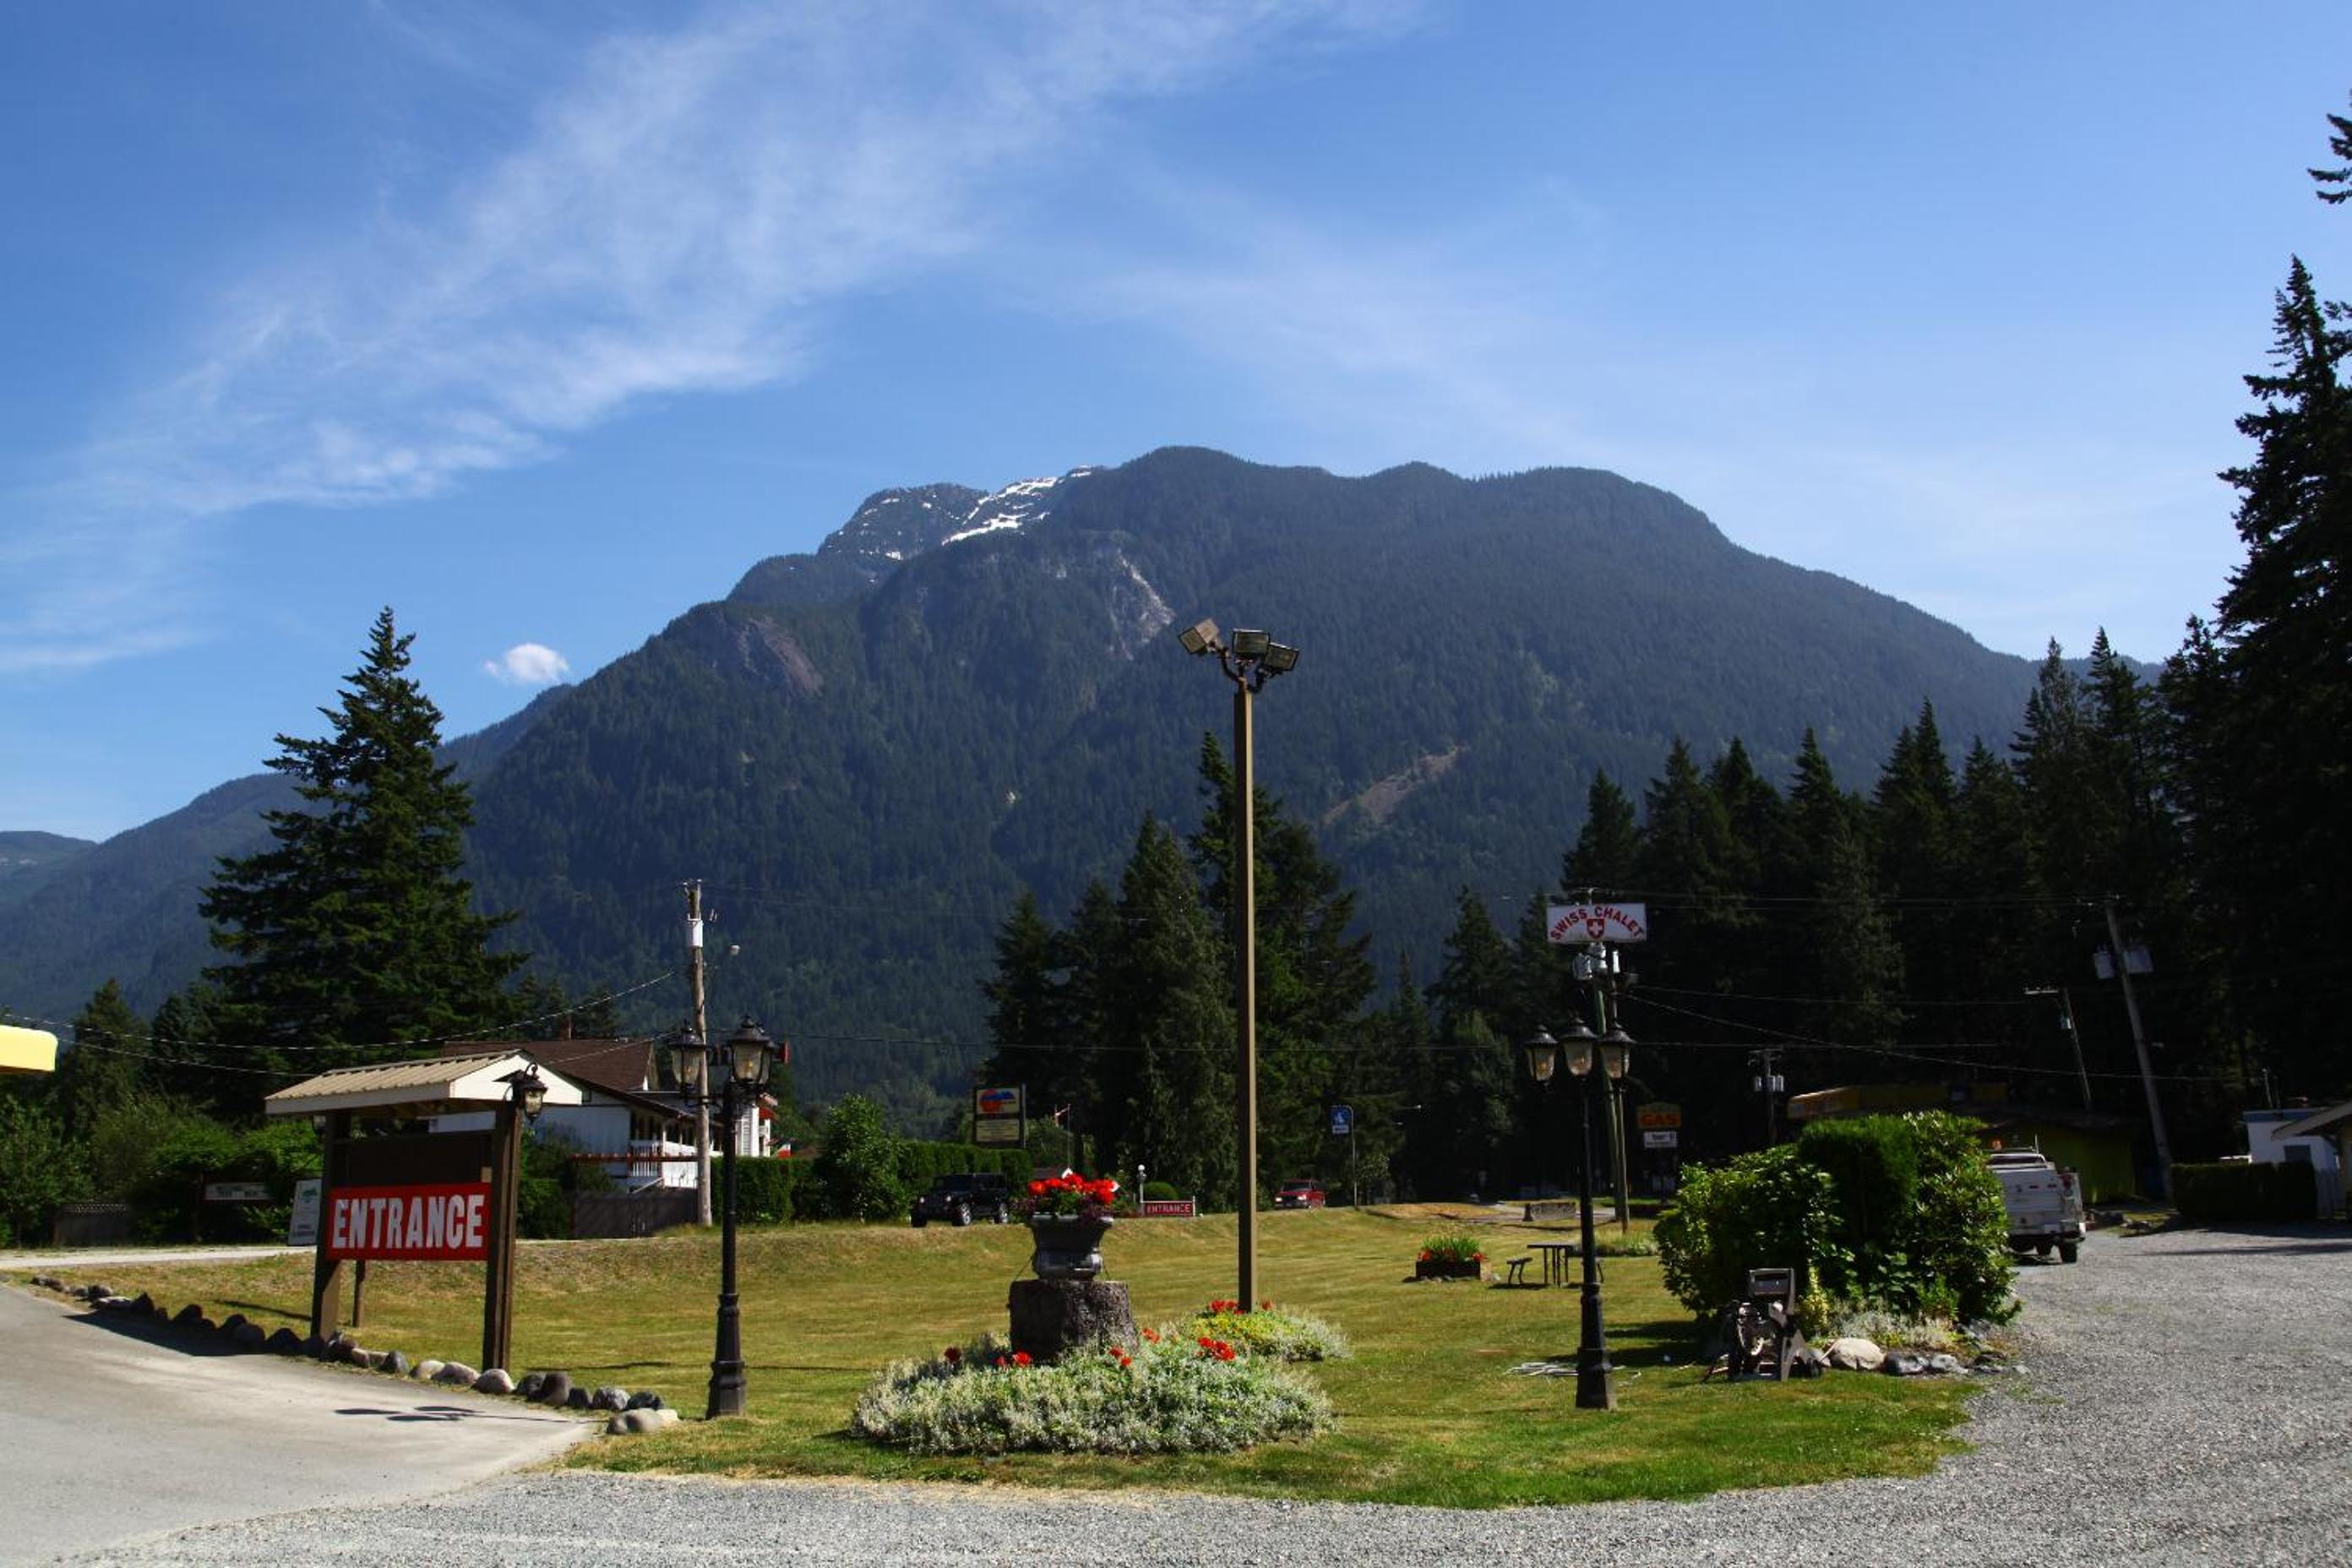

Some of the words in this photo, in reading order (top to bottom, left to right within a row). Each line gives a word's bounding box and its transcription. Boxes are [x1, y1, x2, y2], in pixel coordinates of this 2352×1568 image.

[1550, 908, 1587, 939] SWISS
[1594, 906, 1644, 937] CHALET
[1642, 1113, 1680, 1126] GAS
[1146, 1203, 1190, 1213] ENTRANCE
[332, 1194, 485, 1250] ENTRANCE
